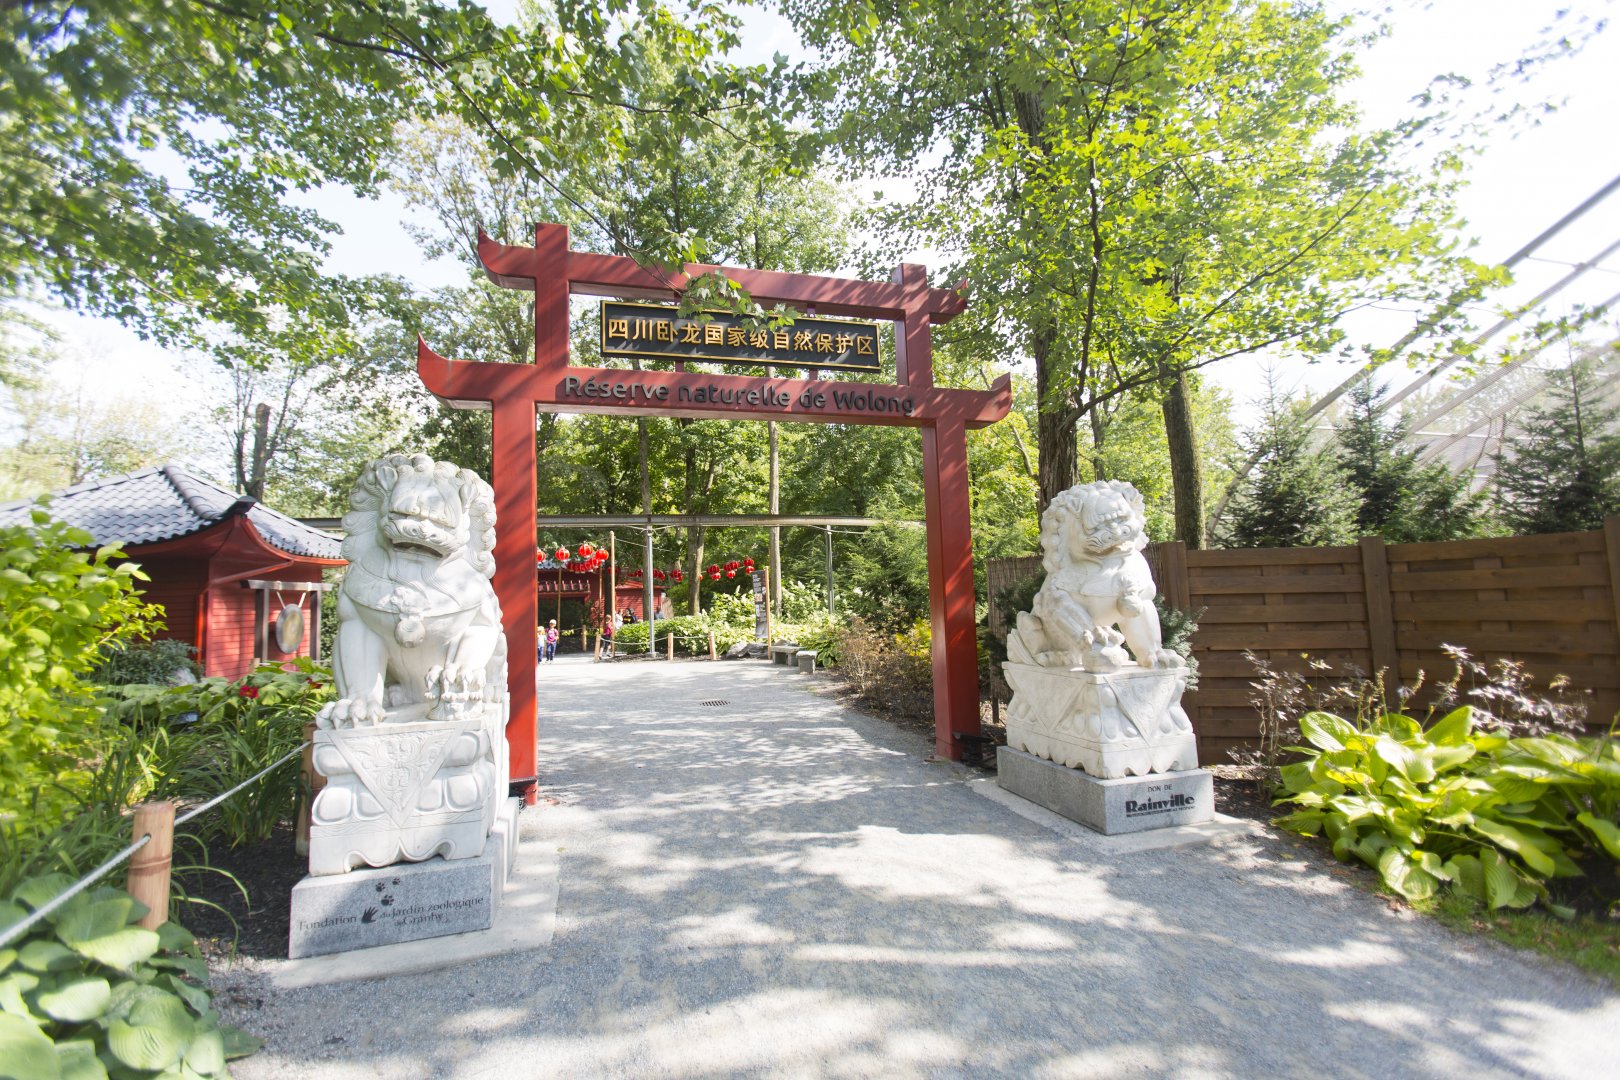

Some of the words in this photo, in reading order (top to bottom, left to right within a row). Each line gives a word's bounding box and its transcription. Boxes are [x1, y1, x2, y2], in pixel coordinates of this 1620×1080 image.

[608, 318, 875, 355] 四川卧龙国家级自然保护区
[565, 375, 669, 401] Réserve
[679, 383, 791, 407] naturelle
[800, 385, 826, 409] de
[834, 390, 915, 417] Wolong
[1125, 794, 1195, 813] Rainville
[1148, 785, 1161, 793] DON
[299, 915, 357, 931] Fondation
[427, 897, 484, 912] zoologique
